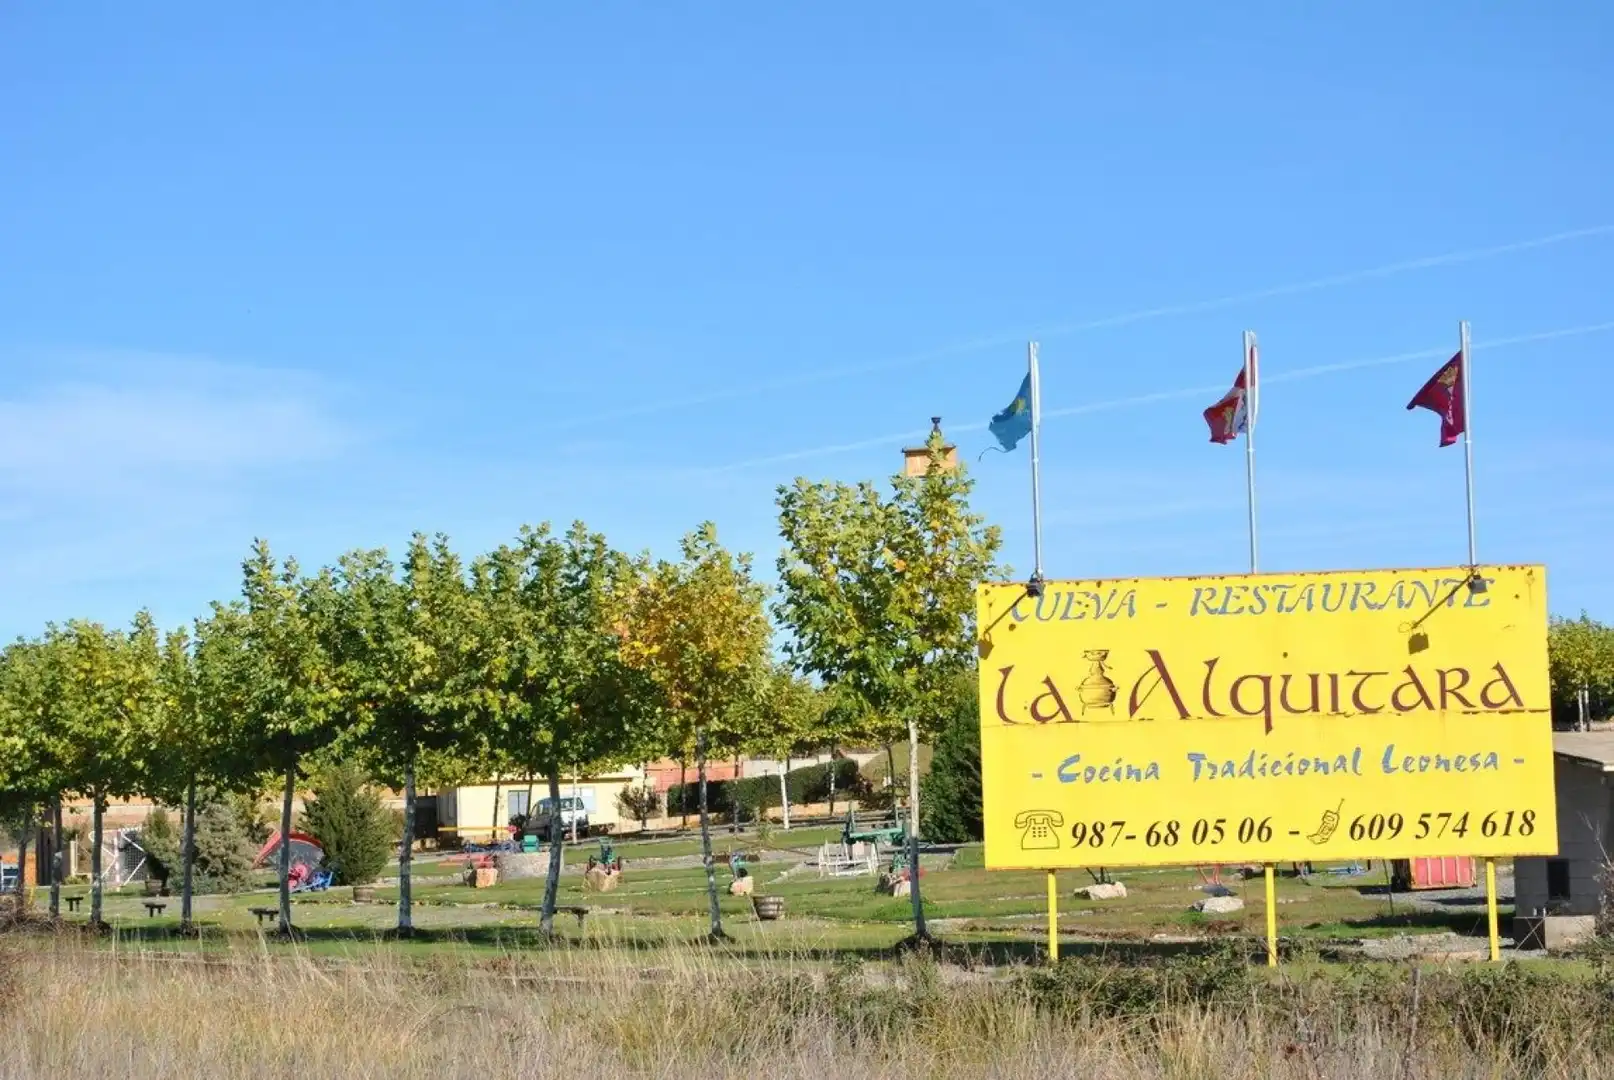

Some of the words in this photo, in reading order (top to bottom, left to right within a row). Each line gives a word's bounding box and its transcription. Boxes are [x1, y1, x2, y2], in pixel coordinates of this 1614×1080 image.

[1010, 588, 1137, 622] CUEVA
[1189, 577, 1496, 616] RESTAURANTE
[1056, 753, 1161, 784] Cocina
[1186, 746, 1363, 782] Tradicional
[1381, 743, 1500, 775] Leonesa
[1144, 819, 1181, 848] 68
[1191, 817, 1227, 846] 05
[1236, 815, 1273, 844] 06
[1348, 812, 1405, 842] 609
[1414, 811, 1469, 840] 574
[1481, 808, 1536, 838] 618
